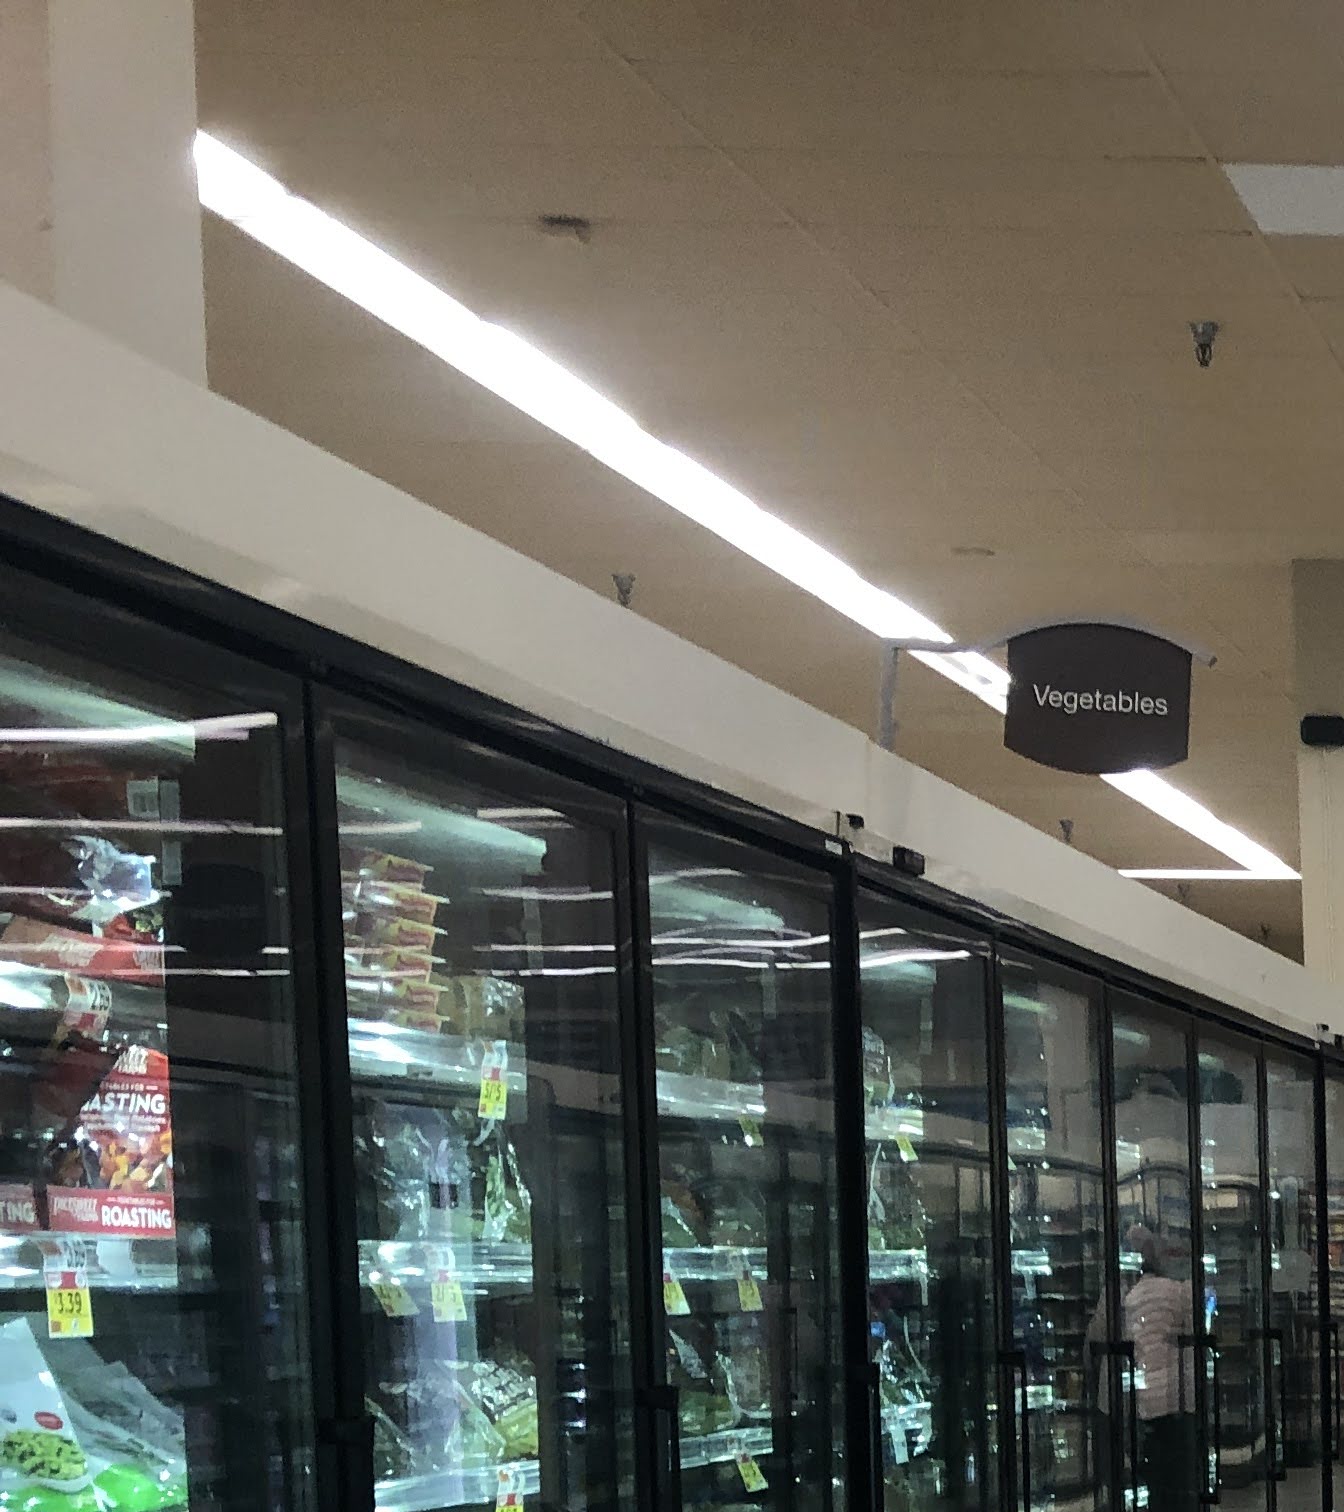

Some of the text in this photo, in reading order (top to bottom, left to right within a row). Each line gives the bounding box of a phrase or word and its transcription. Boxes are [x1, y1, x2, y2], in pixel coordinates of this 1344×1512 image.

[1033, 684, 1168, 715] Vegetables
[82, 1092, 166, 1115] ASTING
[0, 1202, 36, 1223] TING
[101, 1205, 172, 1229] ROASTING
